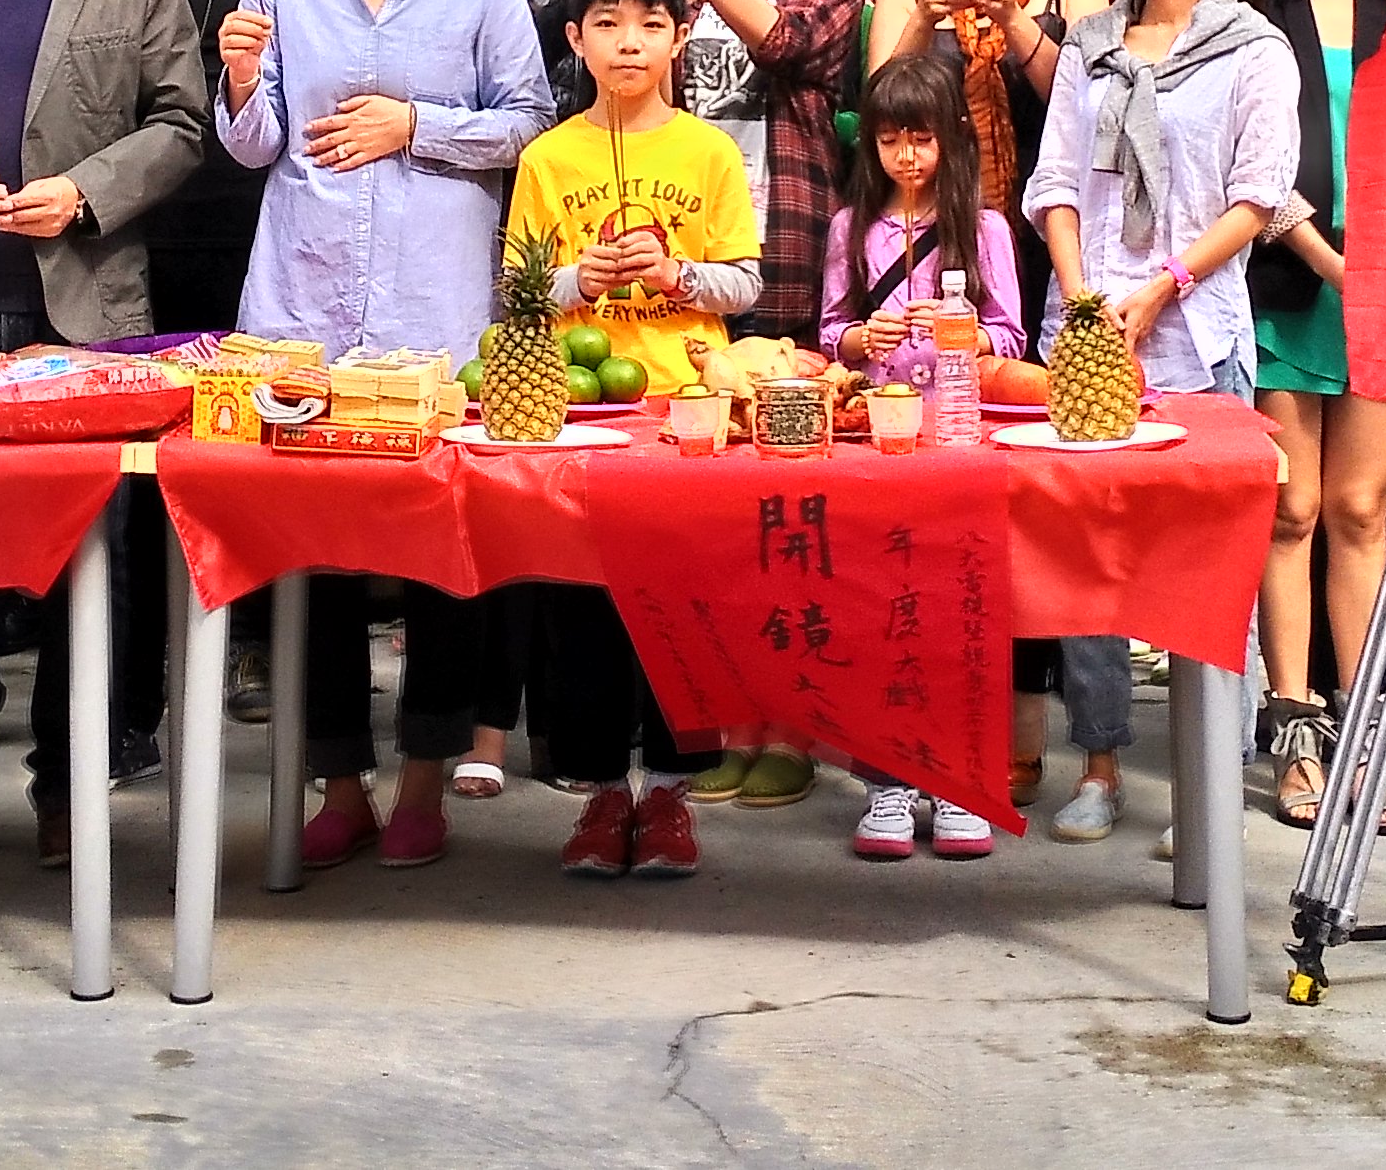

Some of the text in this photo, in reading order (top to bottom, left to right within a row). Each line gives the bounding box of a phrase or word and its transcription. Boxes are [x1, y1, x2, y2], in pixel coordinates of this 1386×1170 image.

[561, 178, 703, 215] PLAY IT LOUD
[586, 299, 688, 322] VERYWHER
